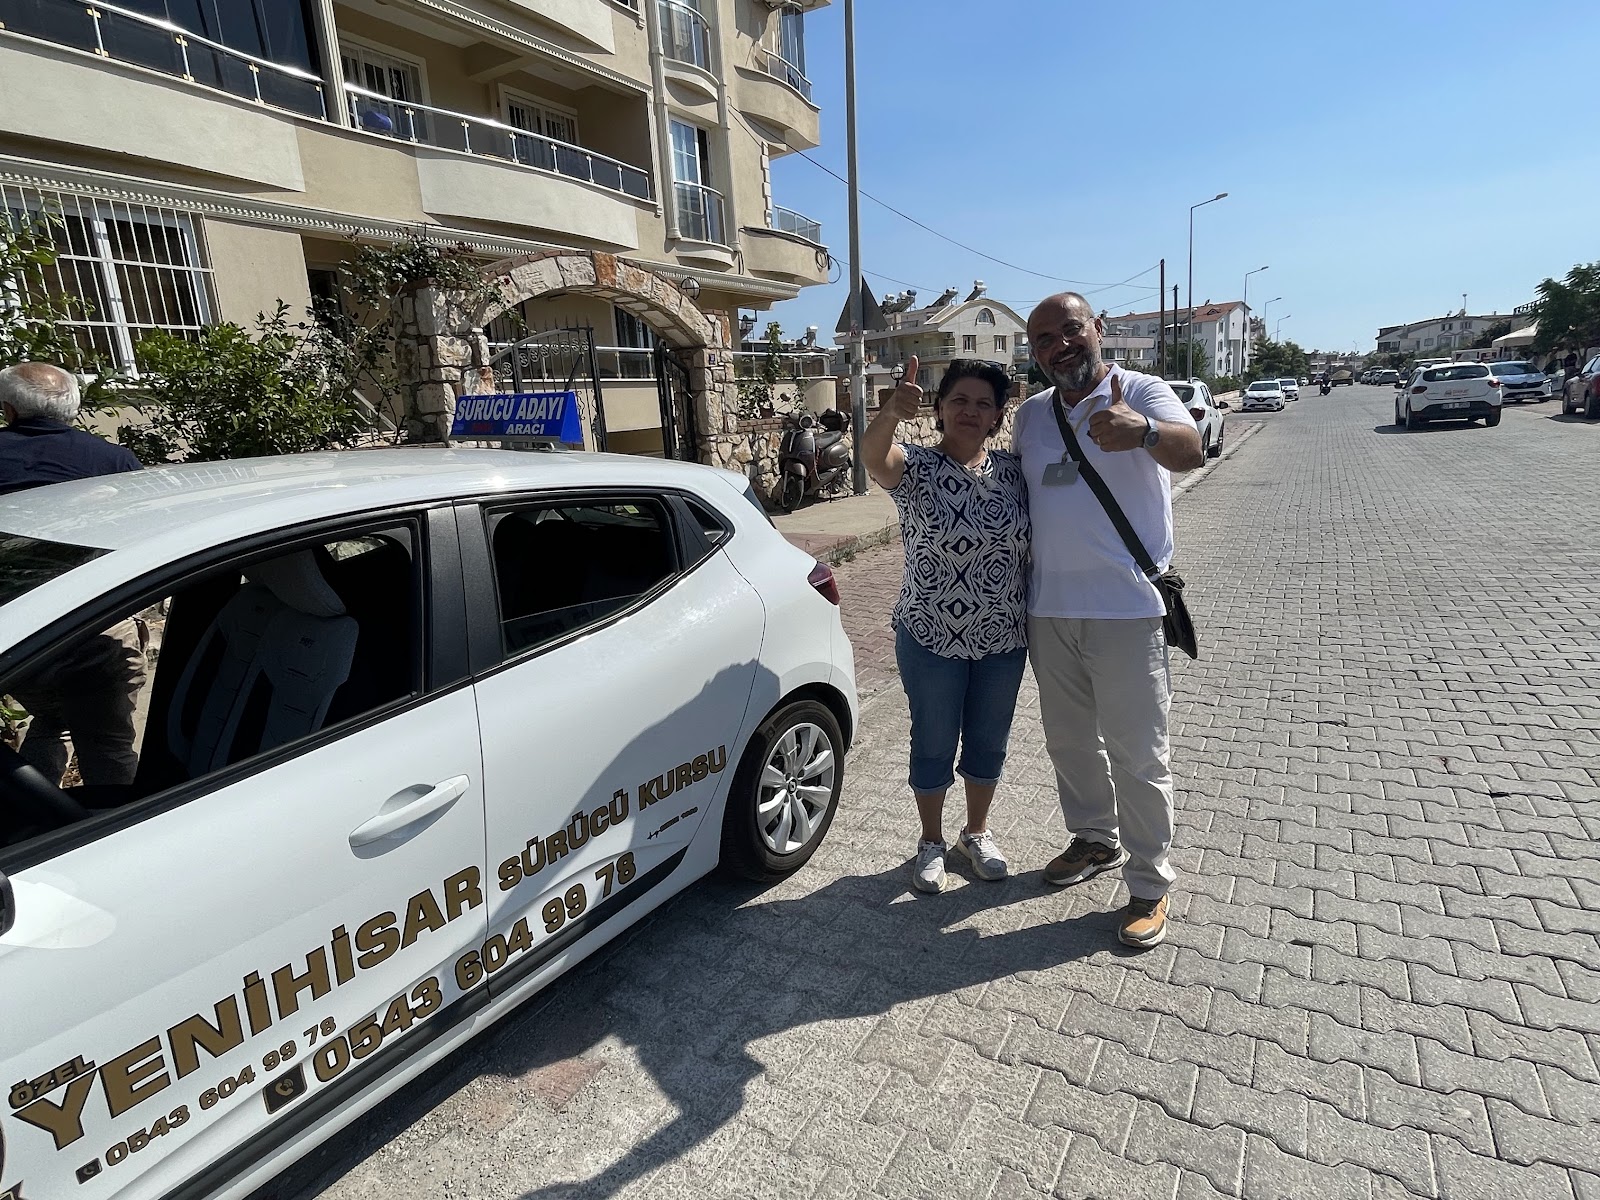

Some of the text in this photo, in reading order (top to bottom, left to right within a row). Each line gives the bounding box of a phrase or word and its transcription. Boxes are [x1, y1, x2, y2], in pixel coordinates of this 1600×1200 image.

[456, 395, 564, 421] SÜRÜCÜ ADAYI
[505, 423, 545, 435] ARACI
[11, 744, 726, 1151] YENİHİSAR SÜRÜCÜ KURSU
[312, 851, 637, 1083] 0543 604 99 78
[8, 1054, 96, 1109] ÖZEL
[105, 1016, 336, 1167] 0543 604 99 78
